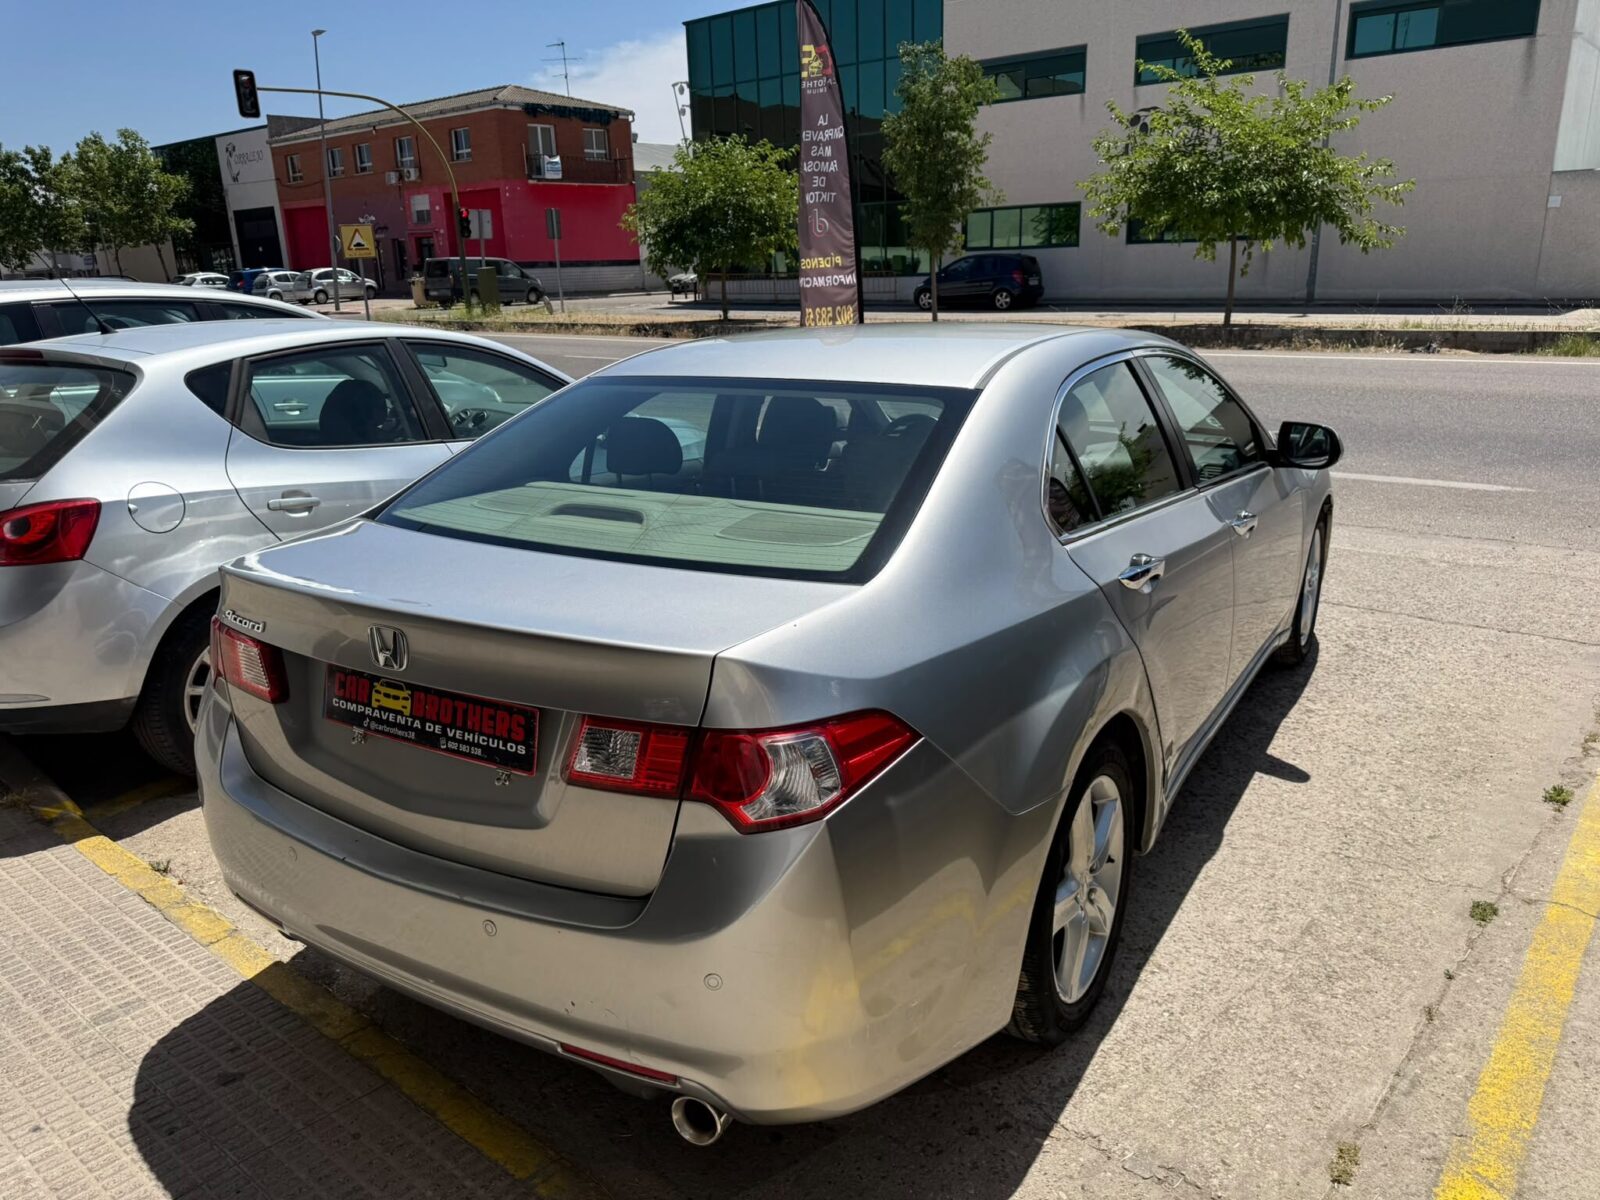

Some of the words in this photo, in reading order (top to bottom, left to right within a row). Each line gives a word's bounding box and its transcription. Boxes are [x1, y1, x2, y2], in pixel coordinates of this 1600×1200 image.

[223, 609, 264, 633] Accord
[332, 698, 421, 729] COMPRAVENTA
[425, 721, 443, 736] DE
[446, 727, 527, 756] VEHÍCULOS
[335, 672, 369, 703] CAR
[412, 691, 526, 742] BROTHERS
